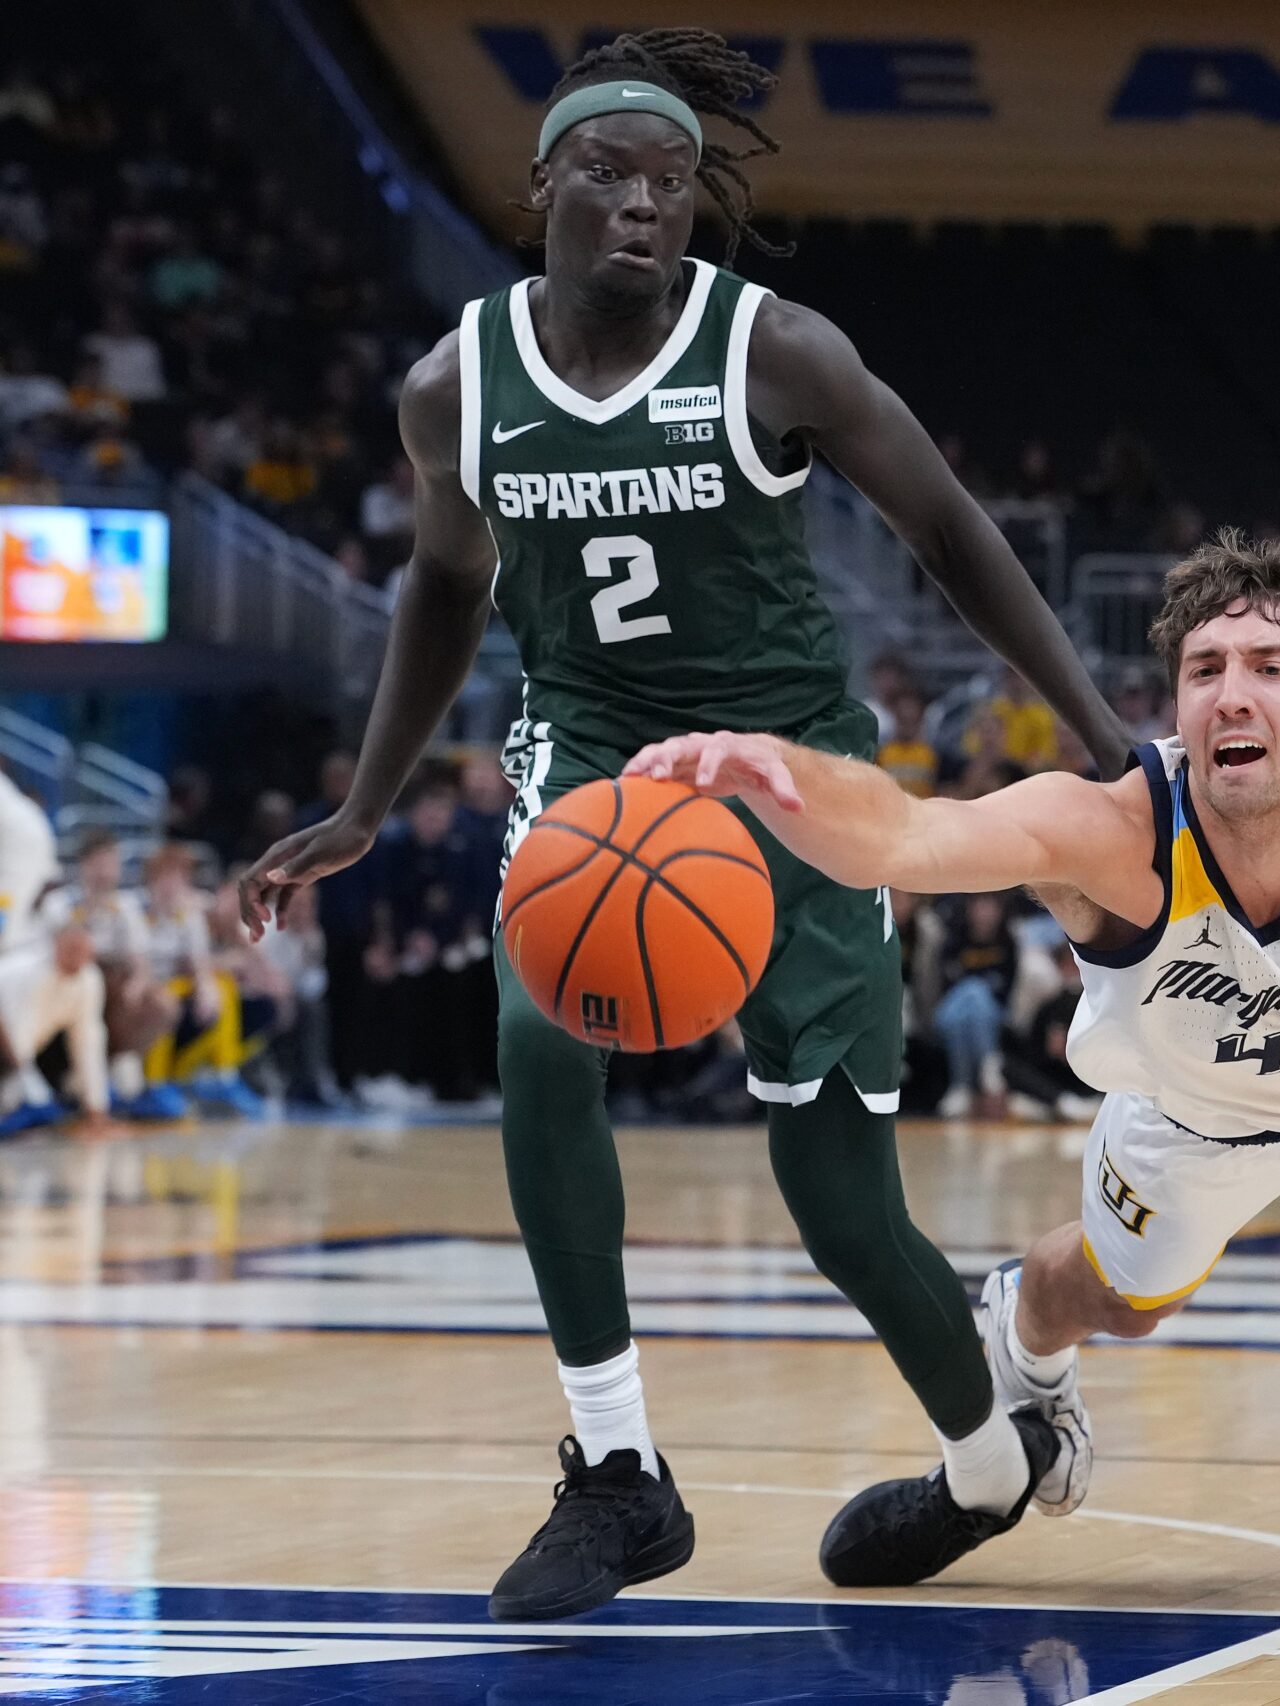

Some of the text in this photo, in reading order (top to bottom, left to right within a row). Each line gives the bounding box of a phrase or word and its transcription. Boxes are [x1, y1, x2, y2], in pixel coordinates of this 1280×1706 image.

[660, 395, 717, 410] msufcu
[492, 462, 726, 520] SPARTANS
[580, 534, 673, 644] 2
